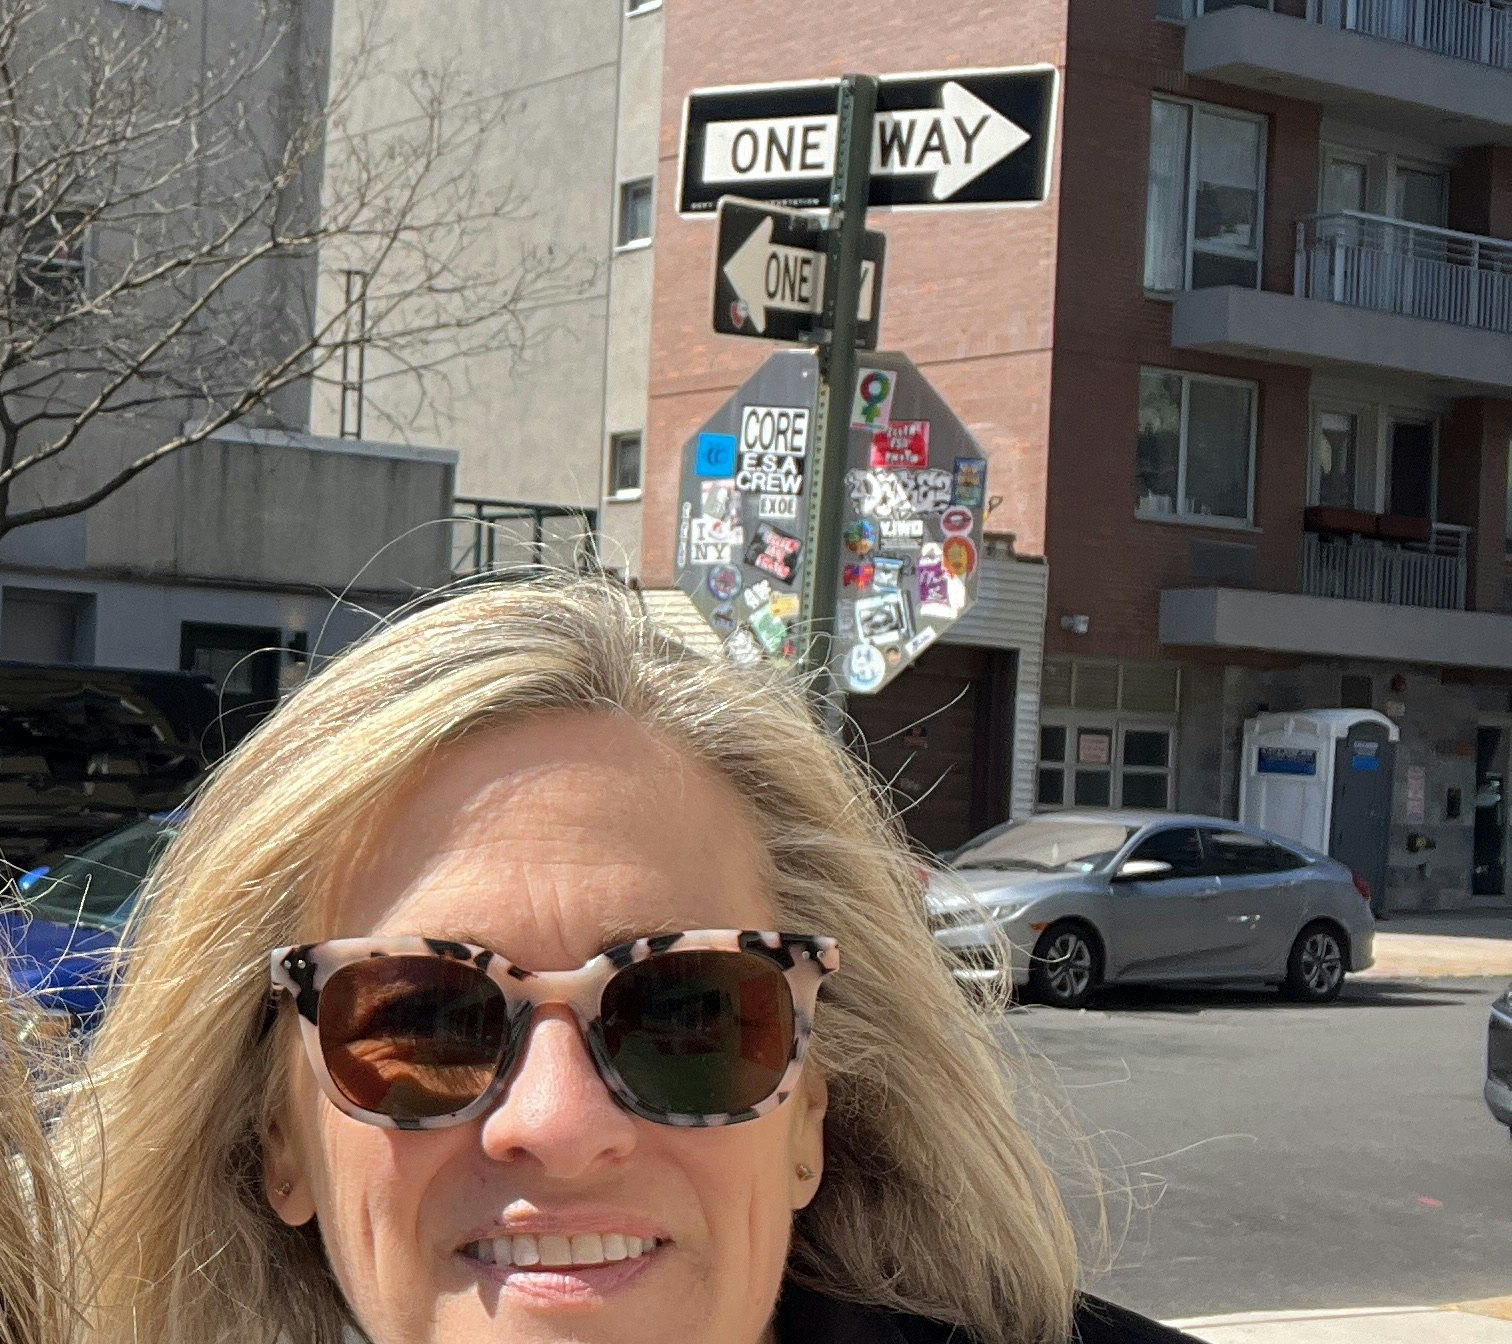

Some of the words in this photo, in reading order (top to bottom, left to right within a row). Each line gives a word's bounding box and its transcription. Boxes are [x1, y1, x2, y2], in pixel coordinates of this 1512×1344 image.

[731, 123, 827, 174] ONE
[879, 114, 991, 168] WAY
[765, 252, 812, 303] ONE
[744, 409, 805, 452] CORE
[736, 471, 803, 494] CREW
[695, 543, 727, 561] NY
